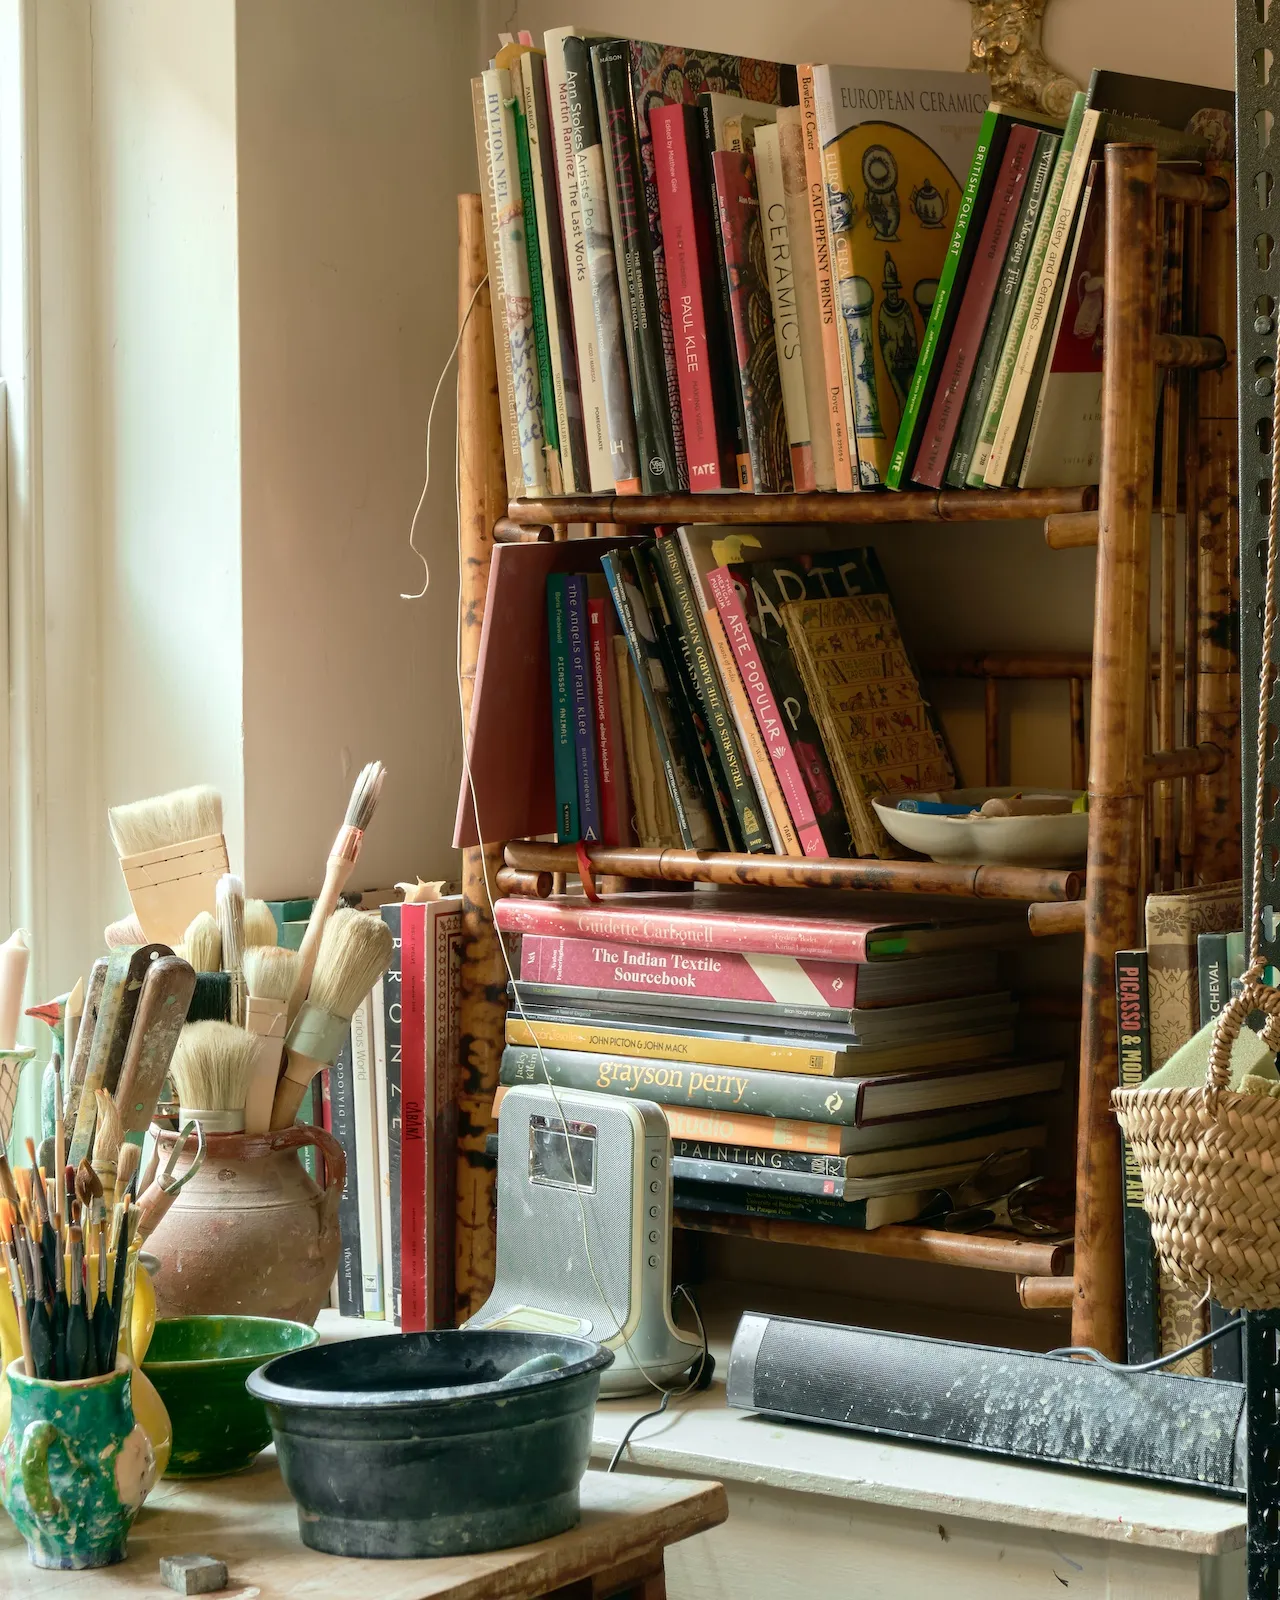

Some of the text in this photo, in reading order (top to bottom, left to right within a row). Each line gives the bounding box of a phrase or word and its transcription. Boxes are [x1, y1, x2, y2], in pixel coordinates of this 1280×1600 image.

[600, 55, 623, 64] MASON
[566, 70, 578, 98] Ann
[841, 87, 990, 114] EUROPEAN CERAMICS
[525, 86, 536, 130] PAULA REGO
[571, 102, 585, 150] Stokes
[702, 107, 711, 139] Bonhams
[802, 77, 816, 150] Bowles & Carver
[488, 93, 508, 202] HYLTON NEL
[666, 141, 673, 150] by
[668, 150, 678, 178] Matthew
[558, 83, 586, 282] Martin The Last Works
[607, 107, 638, 241] KANTHA
[1032, 149, 1053, 194] William
[711, 183, 719, 220] TRANSATLANTIC
[949, 145, 986, 256] BRITISH FOLK ART
[825, 153, 845, 234] EUROPEAN
[836, 237, 855, 316] CERAMICS
[1010, 217, 1035, 264] Morgan
[811, 183, 833, 325] CATCHPENNY PRINTS
[1030, 207, 1071, 331] Pottery and Ceramics
[625, 252, 639, 331] QUILTS OF BENGAL
[636, 269, 648, 329] EMBROIDERED
[768, 203, 801, 361] CERAMICS
[989, 149, 1072, 414] Moulded and Slip Cast Pottery and Ceramics
[1004, 268, 1020, 295] Tiles
[681, 295, 699, 373] PAUL KLEE
[506, 377, 517, 415] Ancient
[831, 386, 840, 414] Dover
[938, 400, 953, 432] SAINT
[949, 355, 966, 395] PIERRE
[510, 420, 519, 456] Persia
[594, 406, 604, 452] POMEGRANATE
[692, 463, 716, 476] TATE
[892, 451, 904, 472] TATE
[568, 583, 578, 606] The
[616, 572, 627, 602] TRANSPORTED
[711, 577, 726, 610] MUSEUM
[715, 573, 732, 607] MEXICAN
[724, 578, 734, 595] THE
[573, 657, 582, 671] of
[594, 652, 604, 695] GRASSHOPPER
[663, 539, 743, 790] TREASURES OF THE BARDO NATIONAL MUSEUM
[727, 613, 781, 742] ARTE POPULAR
[557, 656, 568, 745] PICASSO'S ANIMALS
[598, 695, 606, 720] LAUGHS
[577, 706, 587, 736] Klee
[601, 748, 609, 770] Michael
[667, 769, 678, 789] SCOTTISH
[783, 825, 793, 842] TARA
[578, 916, 713, 943] Guidette Carbonell
[556, 939, 565, 981] Fotheringham
[592, 947, 722, 973] The Indian Textile
[614, 967, 697, 988] Sourcebook
[1209, 961, 1220, 1011] CHEVAL
[1119, 966, 1141, 1046] PICASSO &
[354, 1007, 367, 1081] Curious World
[589, 1035, 688, 1054] JOHN PICTON & JOHN MACK
[514, 1051, 529, 1080] Jacky
[596, 1061, 750, 1104] grayson perry
[337, 1058, 346, 1135] EL DIÁLOGO
[405, 1101, 422, 1140] CABANA
[680, 1141, 783, 1169] PAINTING
[814, 1198, 835, 1206] Modern
[344, 1247, 352, 1278] BANCAJA
